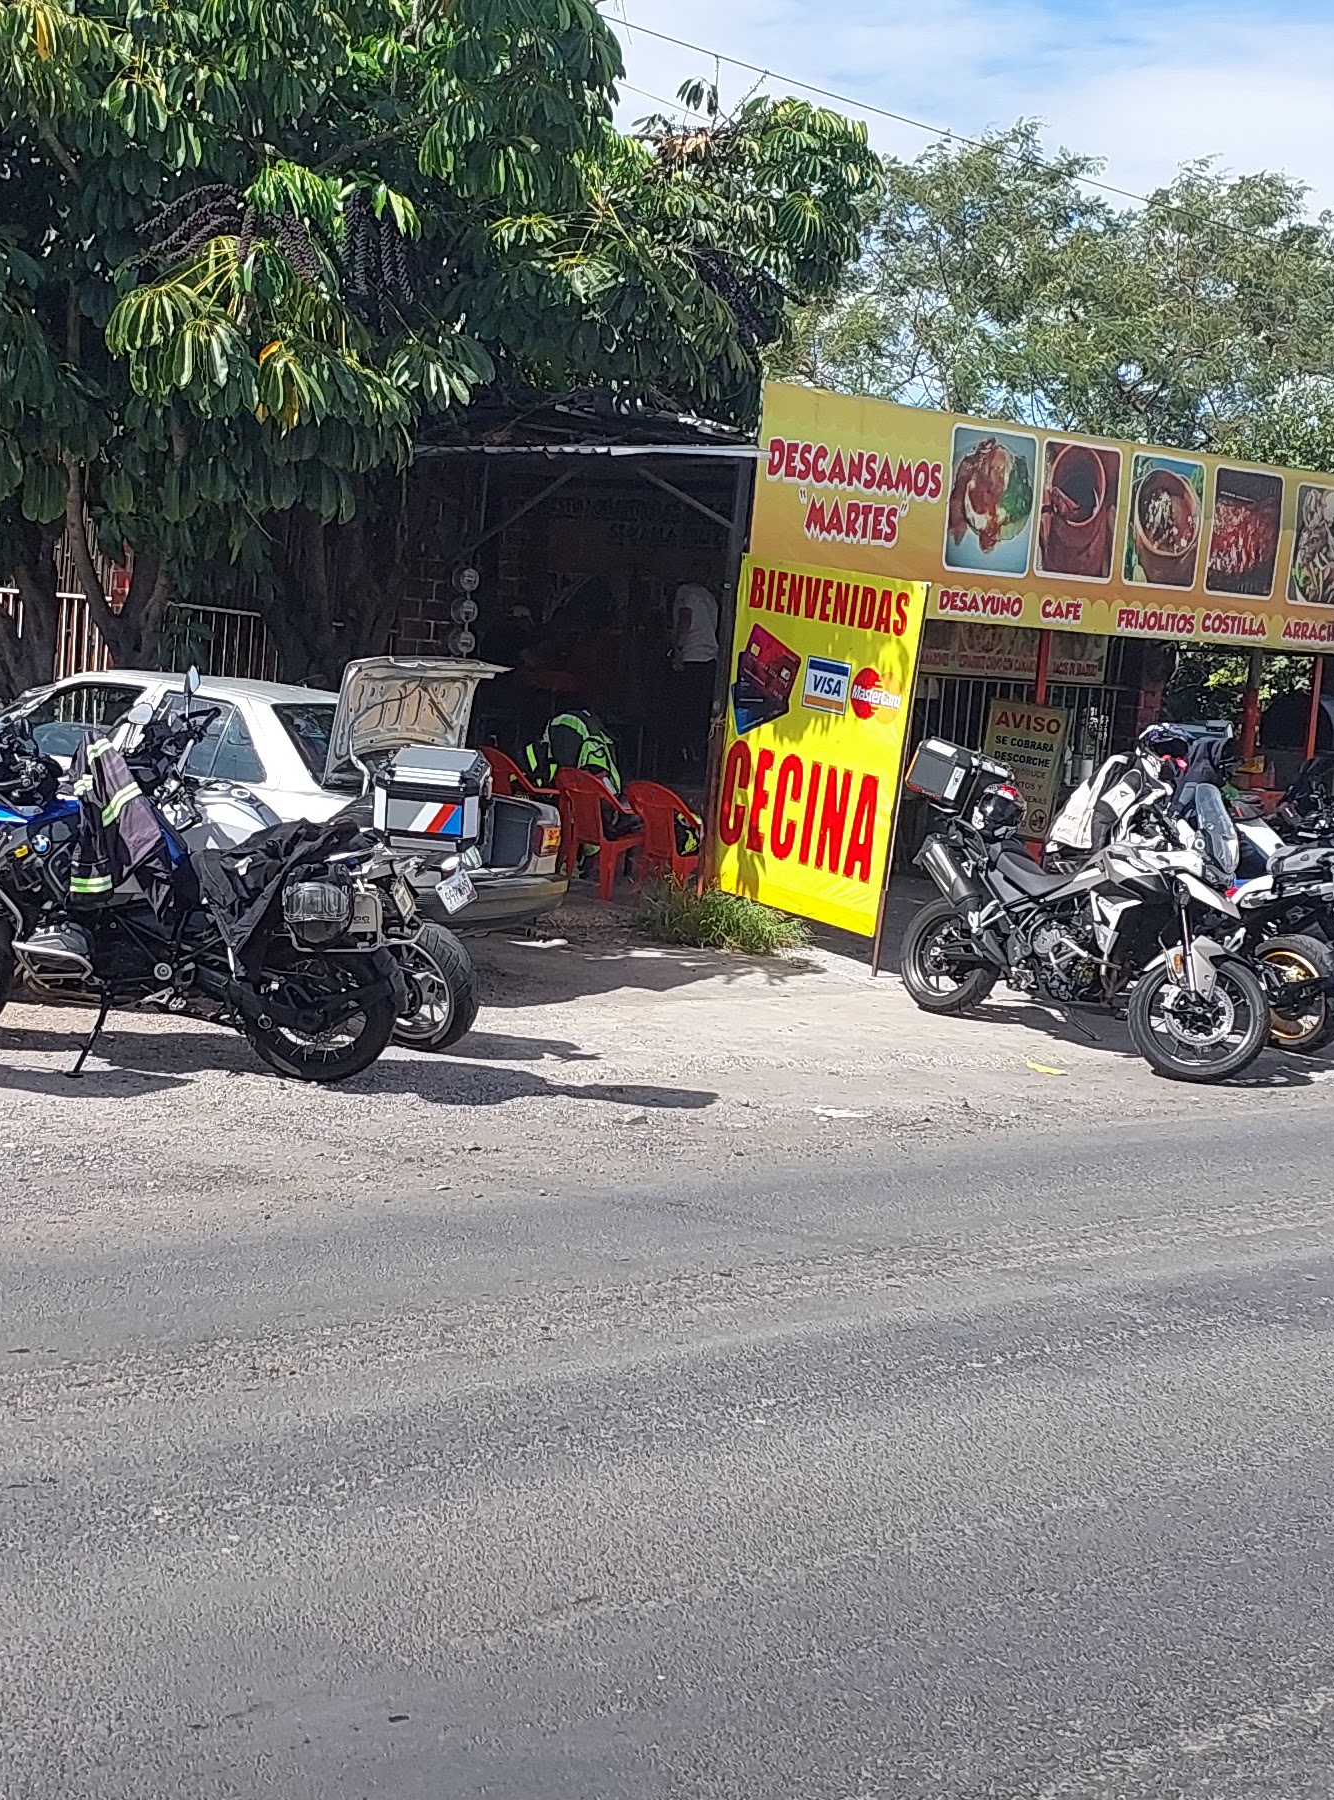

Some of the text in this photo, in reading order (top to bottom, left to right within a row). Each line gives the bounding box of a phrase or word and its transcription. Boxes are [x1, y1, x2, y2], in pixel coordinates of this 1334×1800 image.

[767, 438, 942, 499] DESCANSAMOS
[748, 566, 910, 637] BIENVENIDAS
[938, 589, 1023, 618] DESAYUNO
[1117, 608, 1195, 635] FRIJOLITOS
[1201, 612, 1267, 637] COSTILLA
[812, 673, 843, 698] VISA
[851, 684, 902, 710] MasterCard
[995, 710, 1062, 735] AVISO
[995, 735, 1054, 753] SE COBRARA
[994, 750, 1052, 768] DESCORCHE
[719, 740, 879, 884] CECINA
